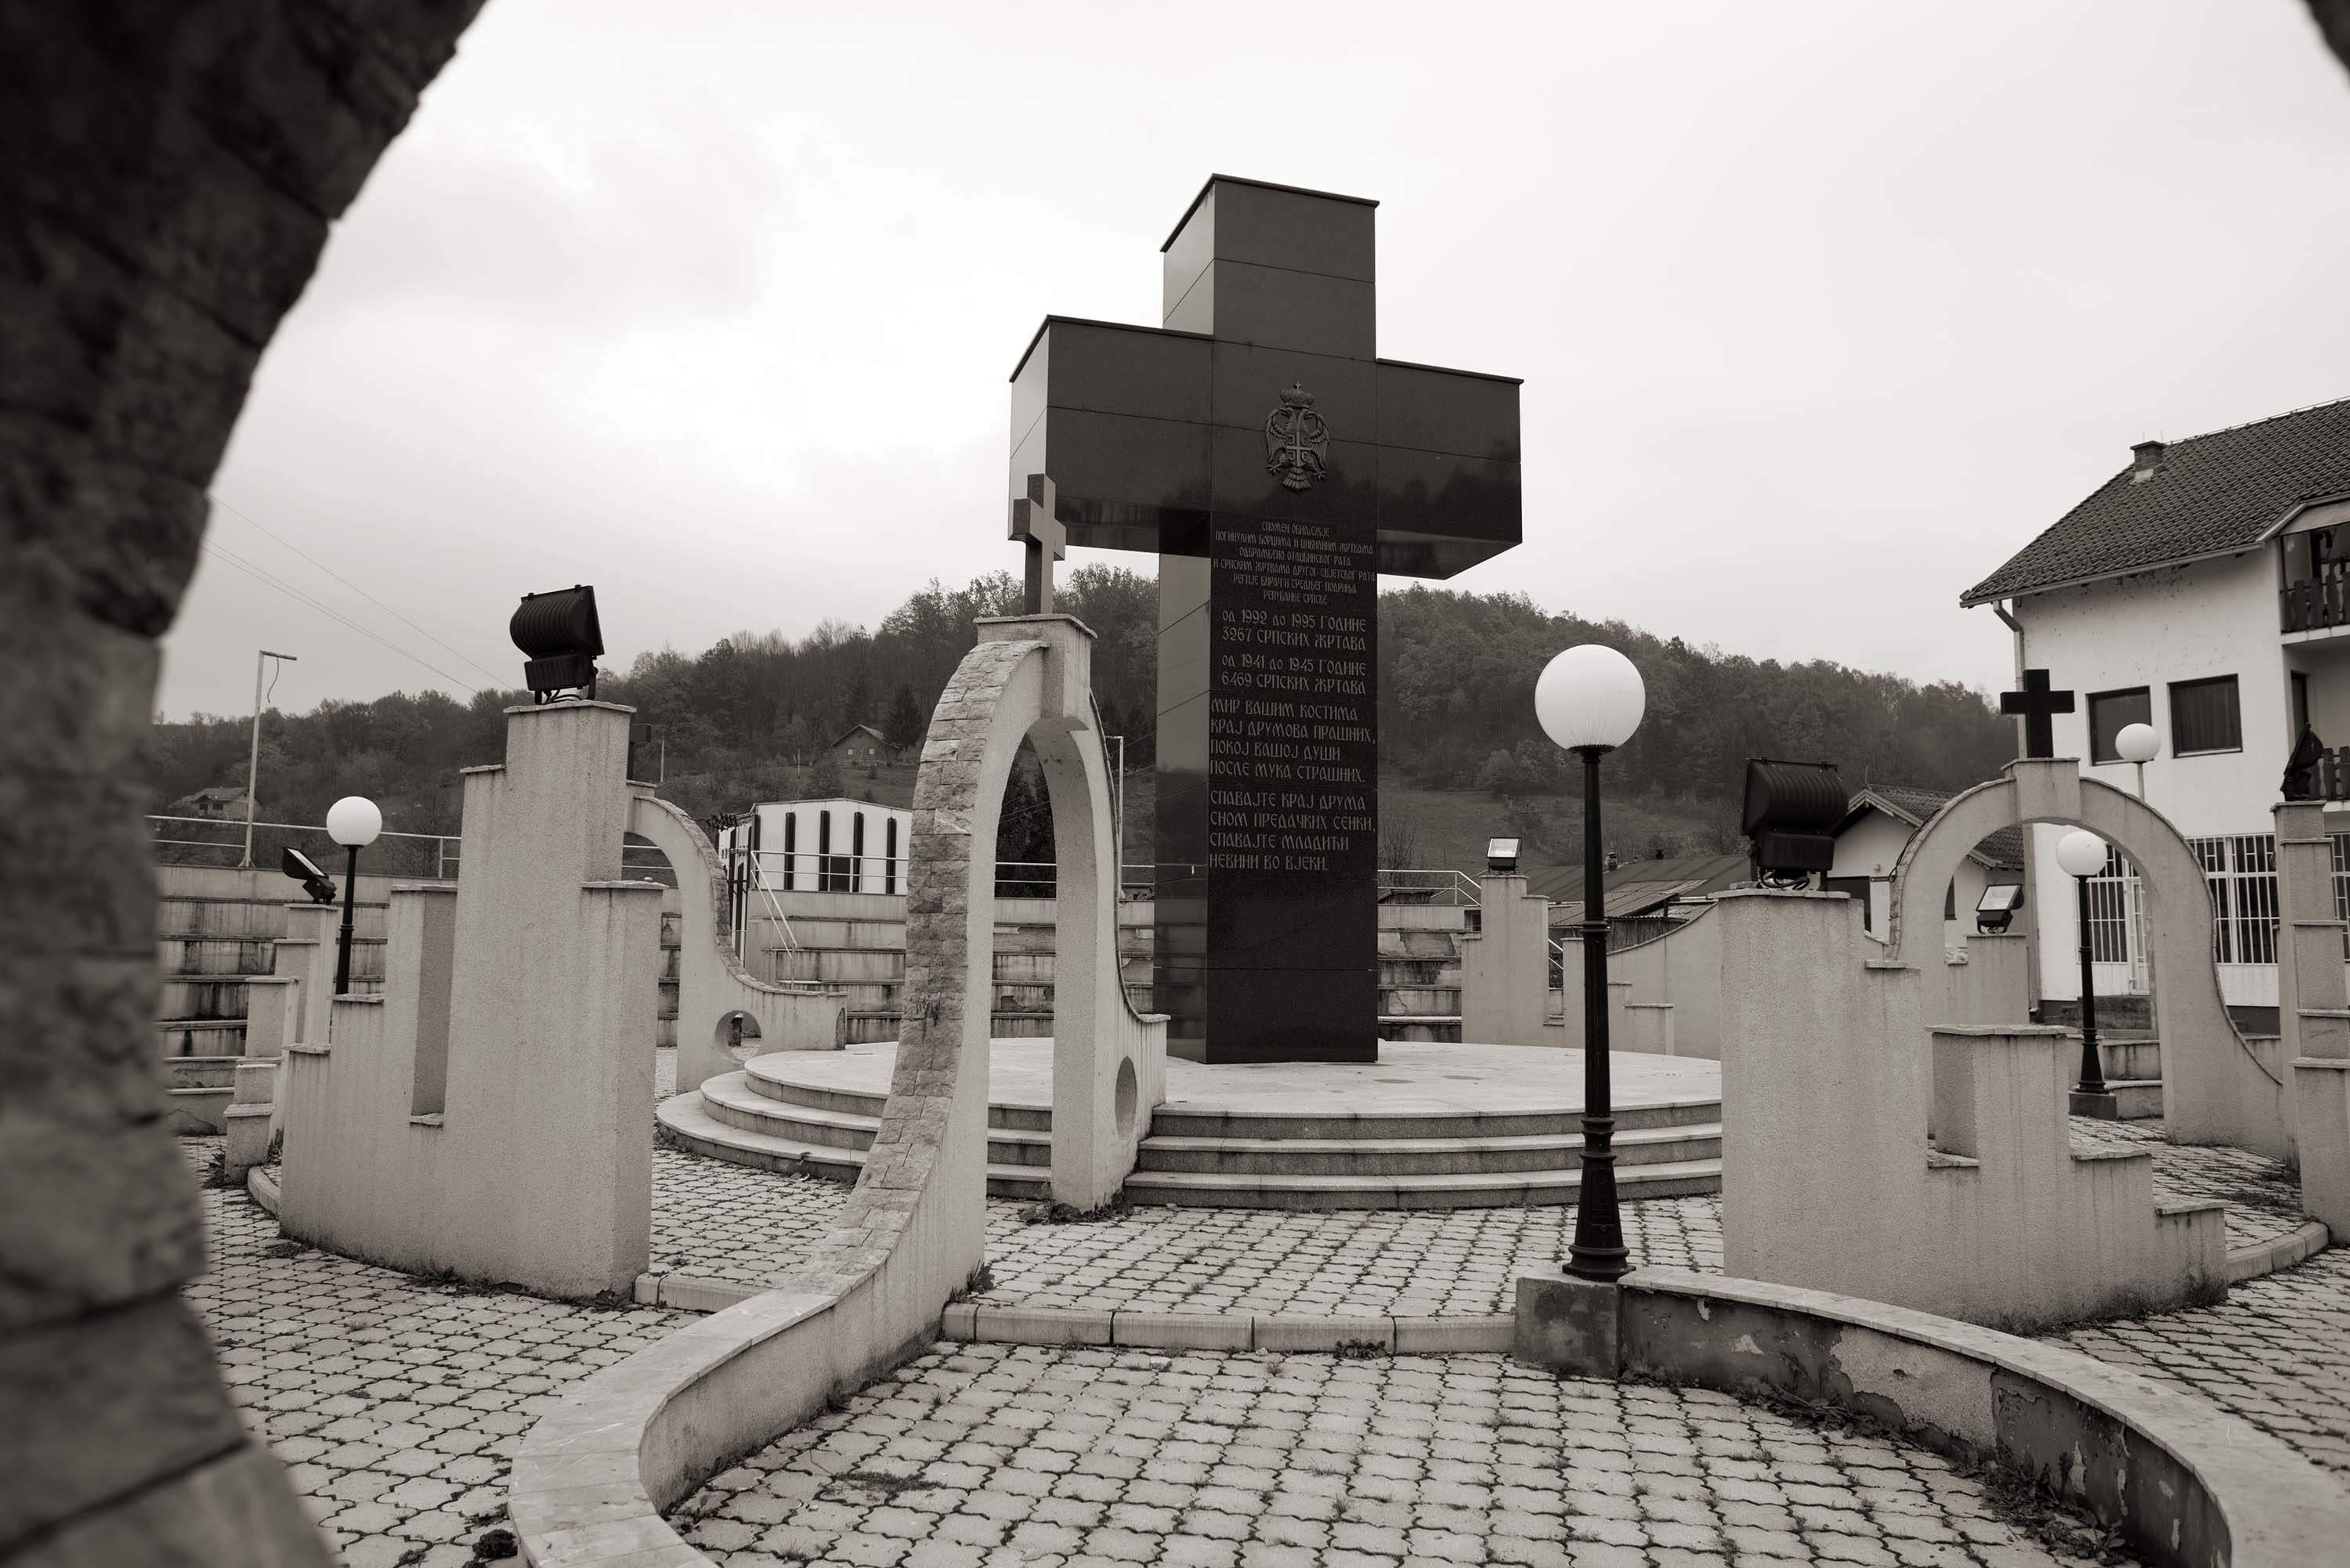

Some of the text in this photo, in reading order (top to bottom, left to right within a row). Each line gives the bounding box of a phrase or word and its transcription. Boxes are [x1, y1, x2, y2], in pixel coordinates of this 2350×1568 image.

[1262, 522, 1289, 533] СПОМЕН
[1215, 530, 1256, 544] ПОГИНУЛИМ
[1259, 534, 1292, 547] БОРЦИМА
[1294, 539, 1299, 547] И
[1339, 543, 1373, 555] ЖРТВАМА
[1240, 547, 1284, 560] ОДБРАМБЕНО
[1334, 555, 1350, 565] РАТА
[1214, 558, 1218, 568] И
[1220, 558, 1253, 571] СРПСКИМ
[1256, 562, 1290, 574] ЖРТВАМА
[1321, 568, 1357, 580] СВЈЕТСКОГ
[1358, 571, 1376, 581] РАТА
[1261, 576, 1282, 587] БИРАЧ
[1285, 578, 1289, 587] И
[1292, 579, 1321, 591] СРЕДЊЕГ
[1264, 590, 1327, 605] РЕПУБЛИКЕ СРПСКЕ
[1242, 609, 1267, 625] 1992
[1292, 614, 1315, 628] 1995
[1321, 616, 1366, 632] ГОДИНЕ
[1222, 627, 1366, 651] 3267 СРПСКИХ ЖРТАВА
[1242, 654, 1264, 669] 1941
[1289, 658, 1314, 672] 1945
[1319, 659, 1366, 676] ГОДИНЕ
[1222, 671, 1366, 695] 6469 СРПСКИХ ЖРТАВА
[1211, 699, 1358, 721] МИР ВАШИМ КОСТИМА
[1211, 719, 1376, 744] КРАЈ ДРУМОВА ПРАШНИХ,
[1210, 739, 1340, 761] ПОКОЈ ВАШОЈ ДУШИ
[1210, 760, 1365, 782] ПОСЛЕ МУКА СТРАШНИХ.
[1210, 789, 1365, 811] СПАВАЈТЕ КРАЈ ДРУМА
[1210, 811, 1376, 833] СНОМ ПРЕДАЧКИХ СЕНКИ,
[1210, 833, 1349, 851] СПАВАЈТЕ МЛАДИЋИ
[1209, 853, 1328, 870] НЕВИНИ ВО ВЈЕКИ.
